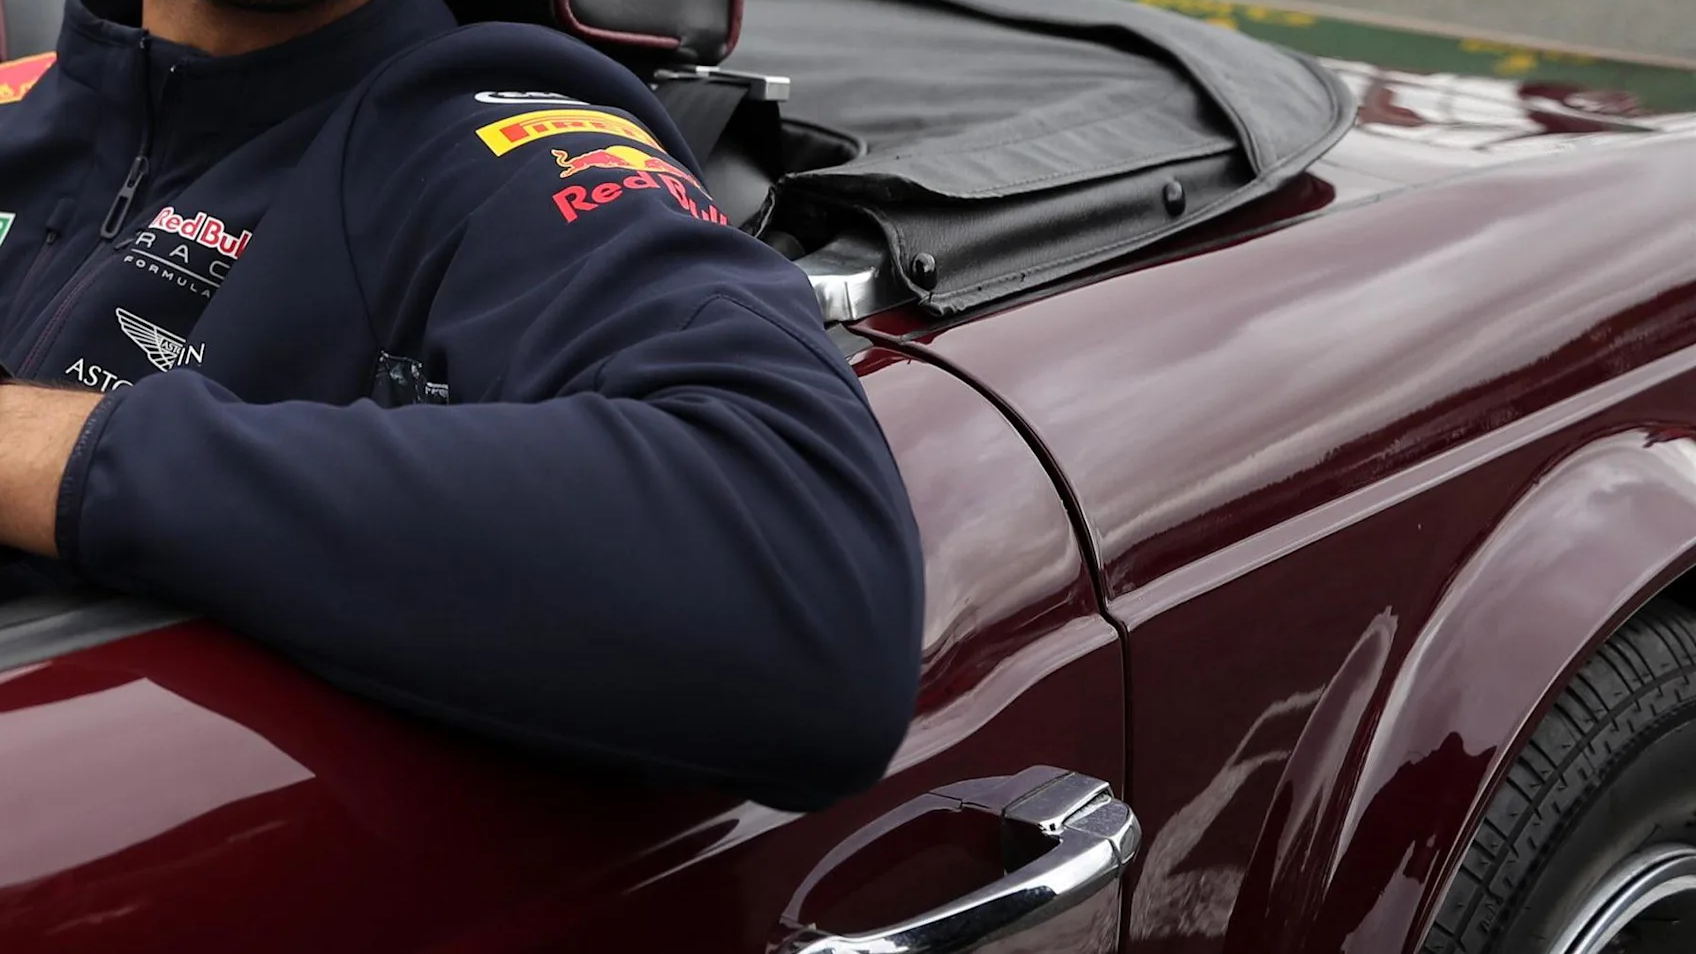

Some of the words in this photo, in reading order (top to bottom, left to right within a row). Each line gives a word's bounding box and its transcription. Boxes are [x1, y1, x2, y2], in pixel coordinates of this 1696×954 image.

[552, 171, 660, 223] Red
[196, 216, 253, 260] Bul
[124, 255, 211, 298] FORMULA
